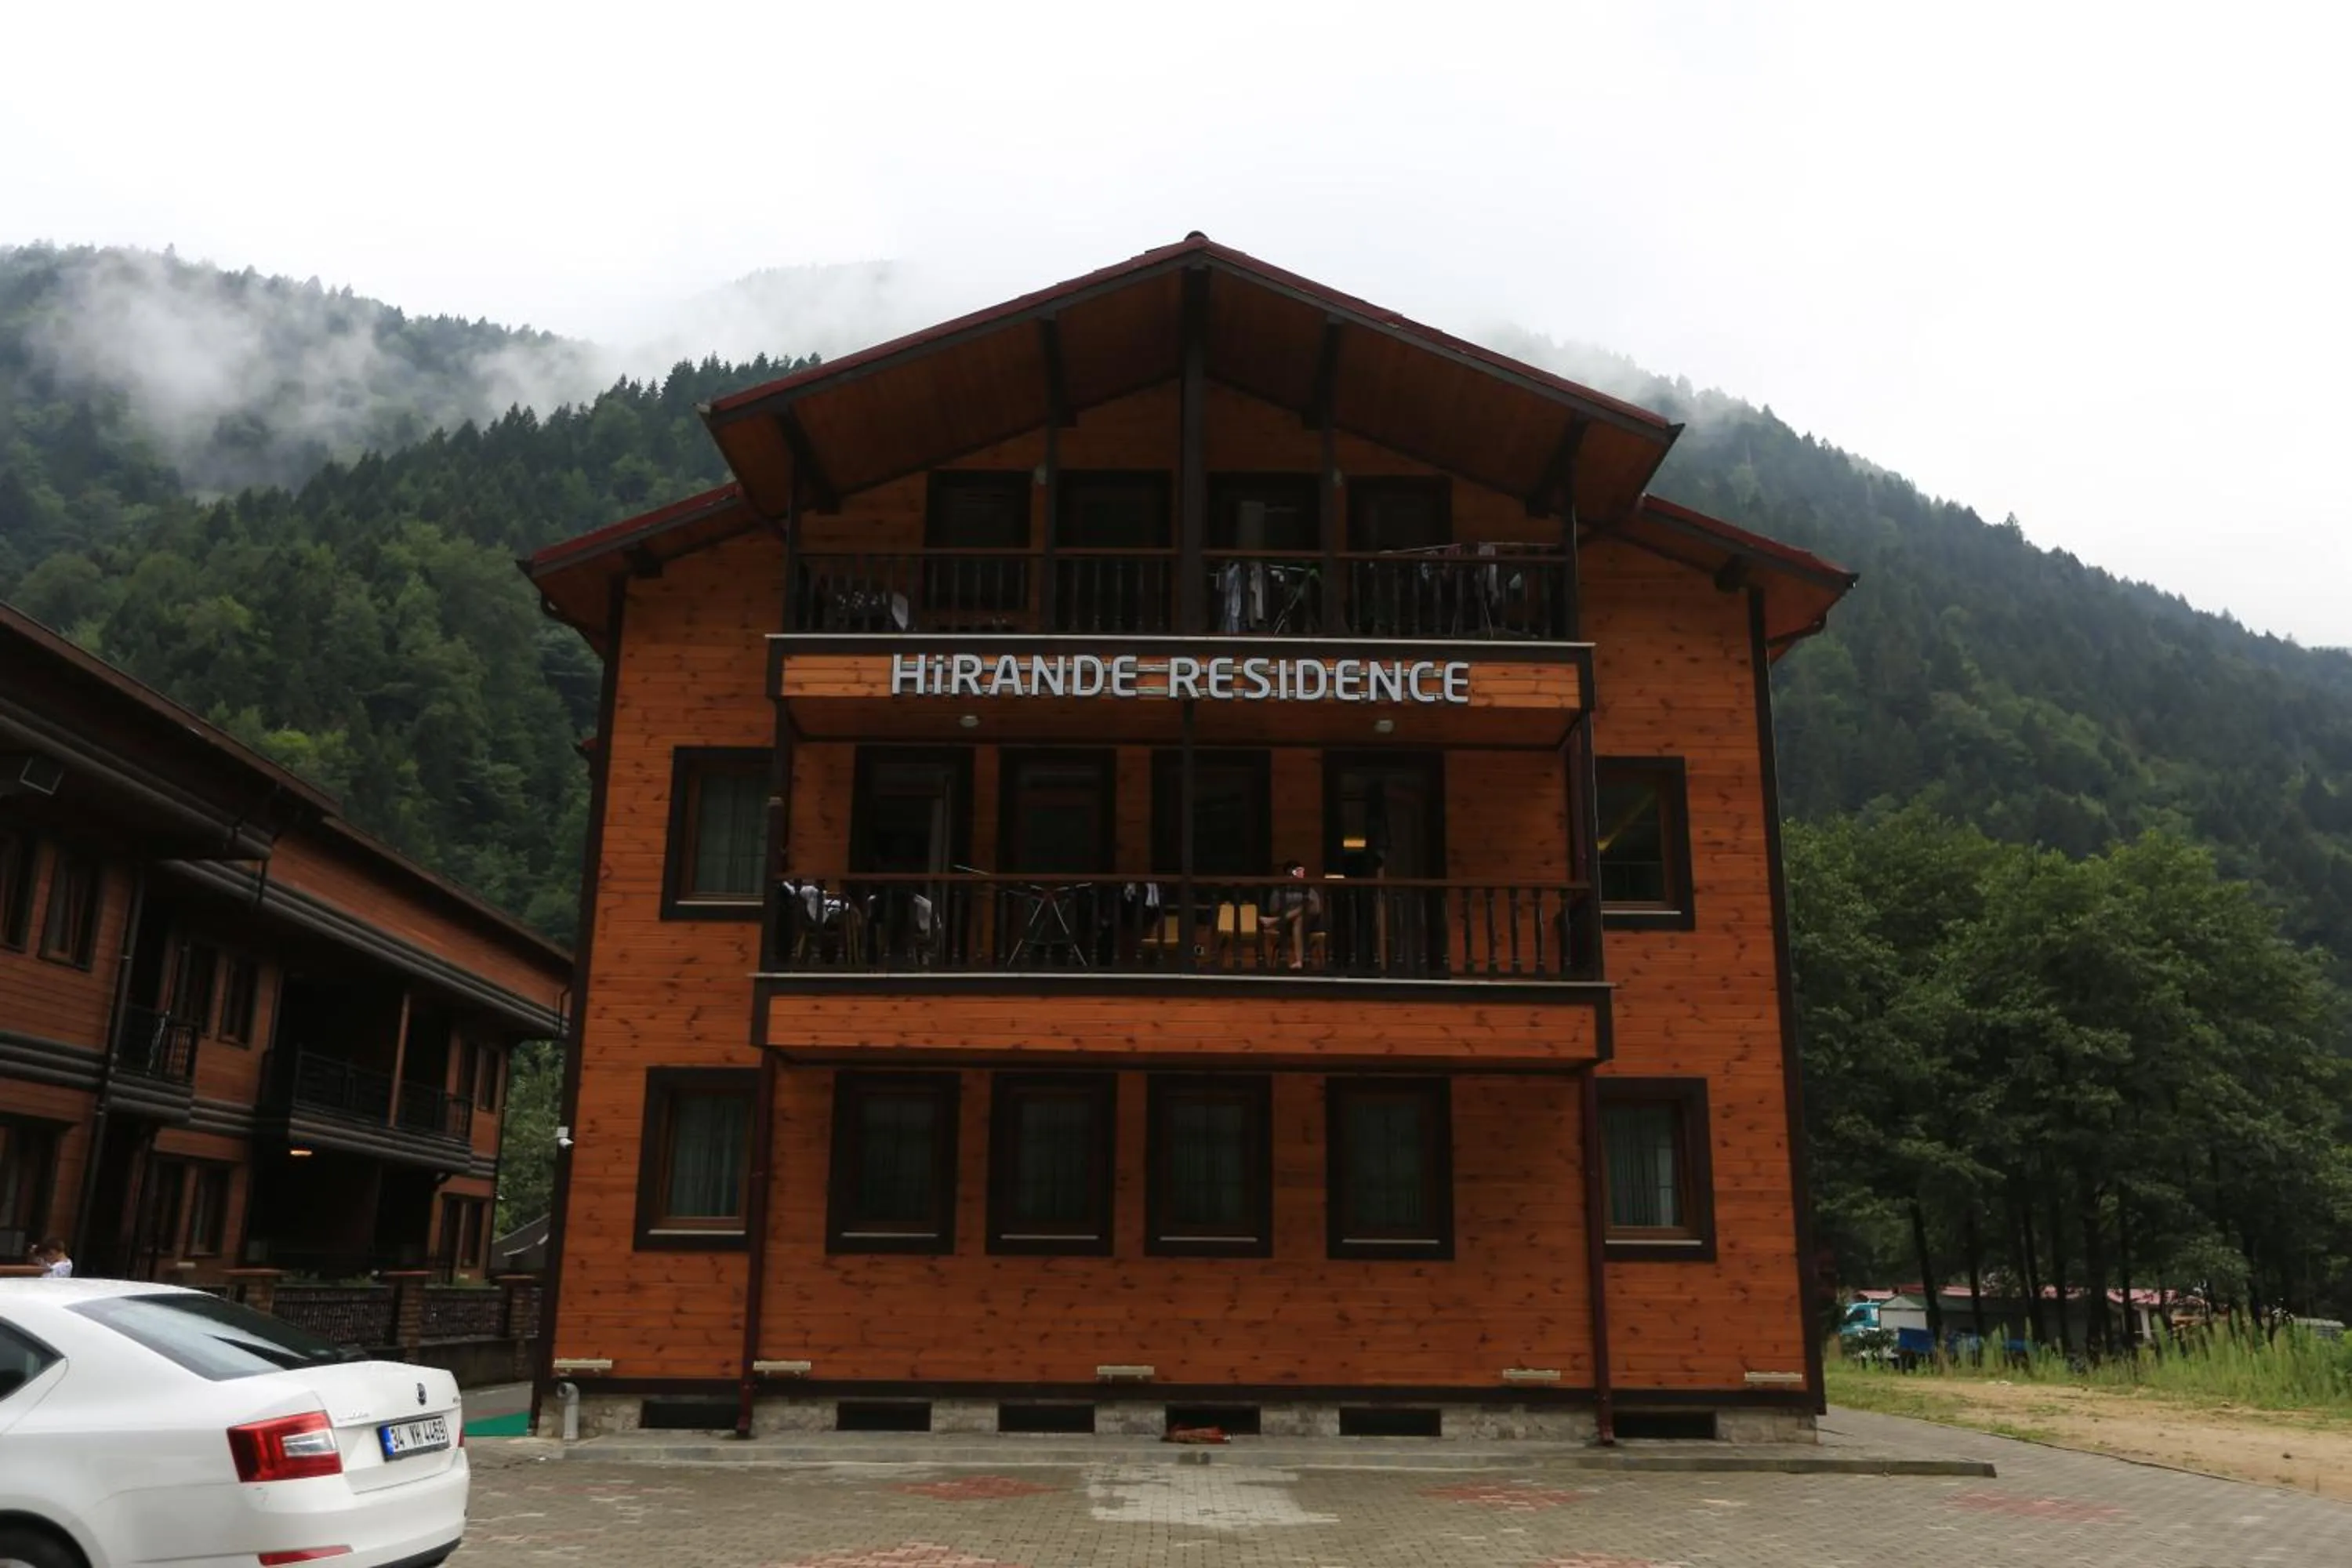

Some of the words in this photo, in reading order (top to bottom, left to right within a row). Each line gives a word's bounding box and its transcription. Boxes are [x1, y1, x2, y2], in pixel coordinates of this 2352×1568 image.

[891, 653, 1138, 697] HiRANDE
[1168, 657, 1469, 702] RESIDENCE
[390, 1426, 405, 1449] 34
